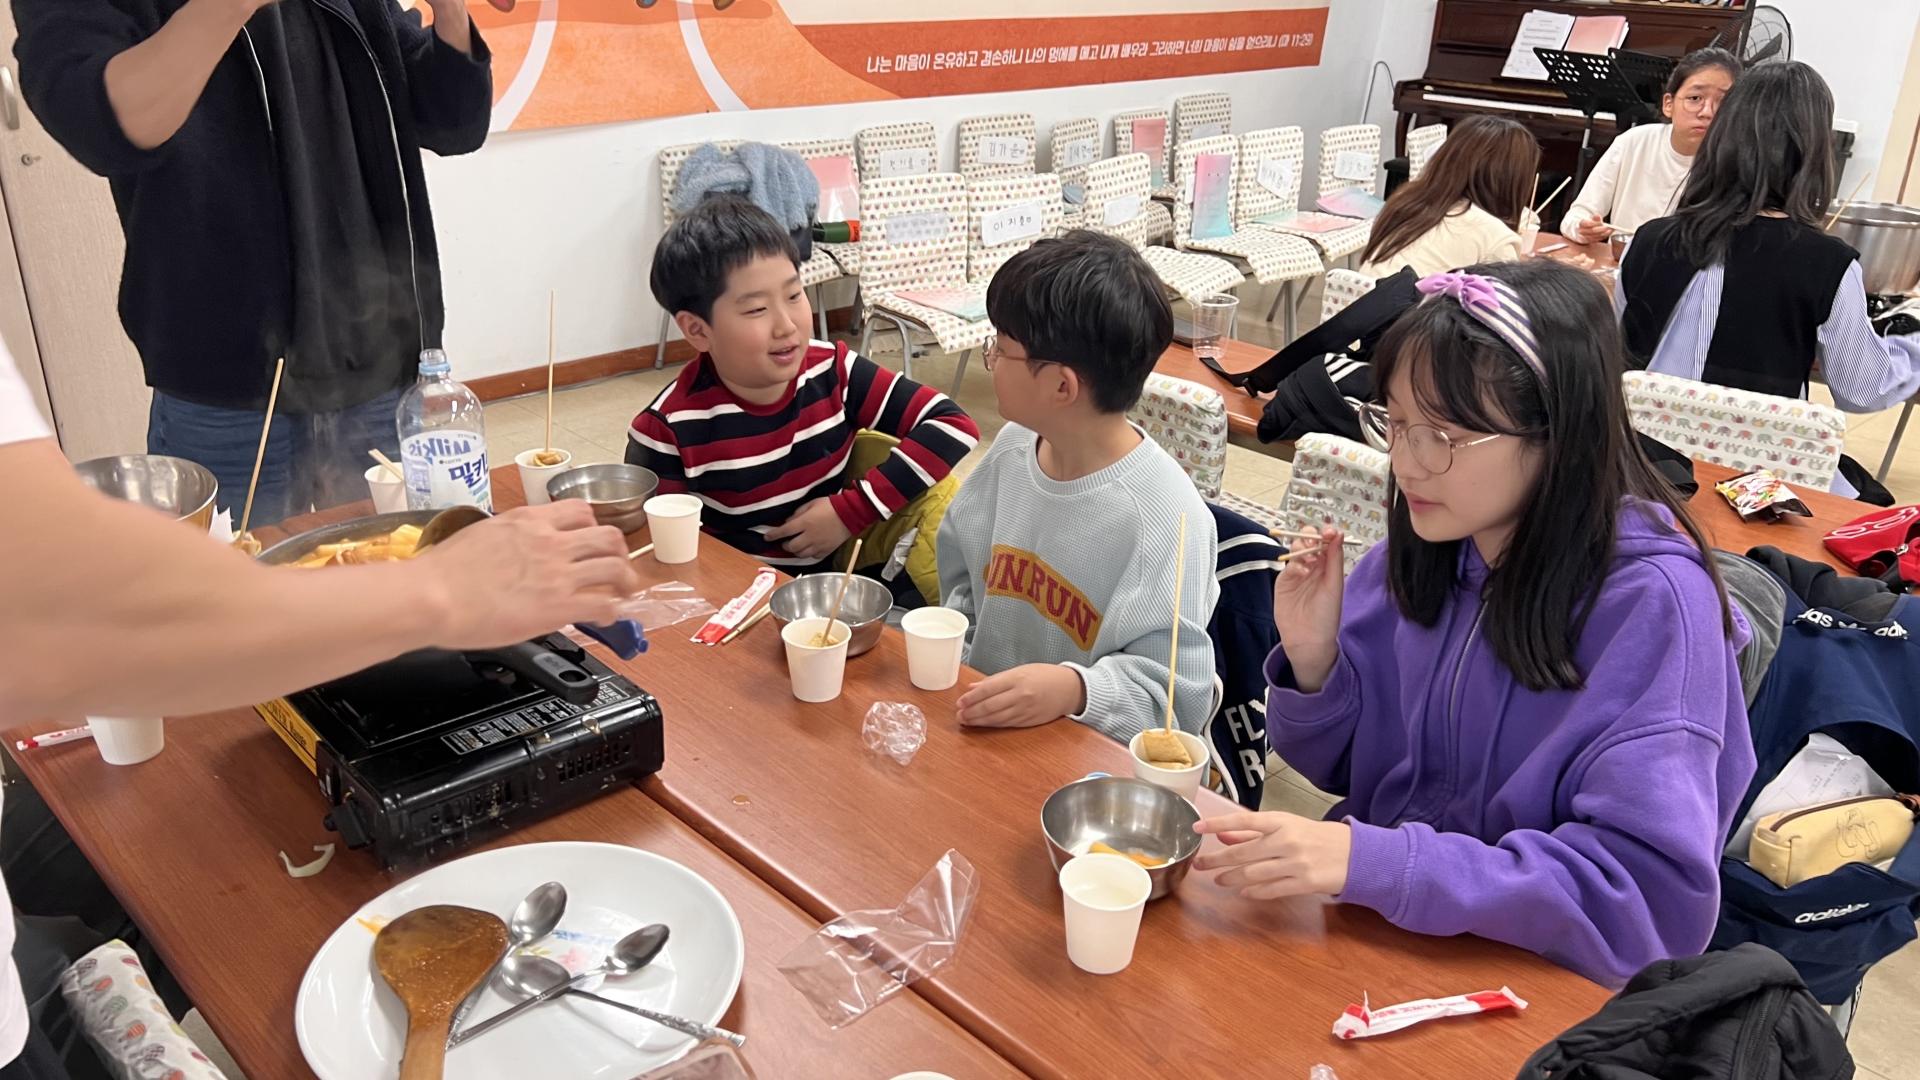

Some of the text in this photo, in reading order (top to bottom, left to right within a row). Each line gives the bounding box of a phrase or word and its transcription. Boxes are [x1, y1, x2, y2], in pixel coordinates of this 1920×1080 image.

[866, 56, 892, 73] 나는
[895, 53, 931, 72] 마음이
[933, 50, 979, 70] 온유하고
[980, 47, 1024, 67] 겸손하니
[1025, 46, 1047, 64] 나의
[448, 449, 488, 489] 밀키
